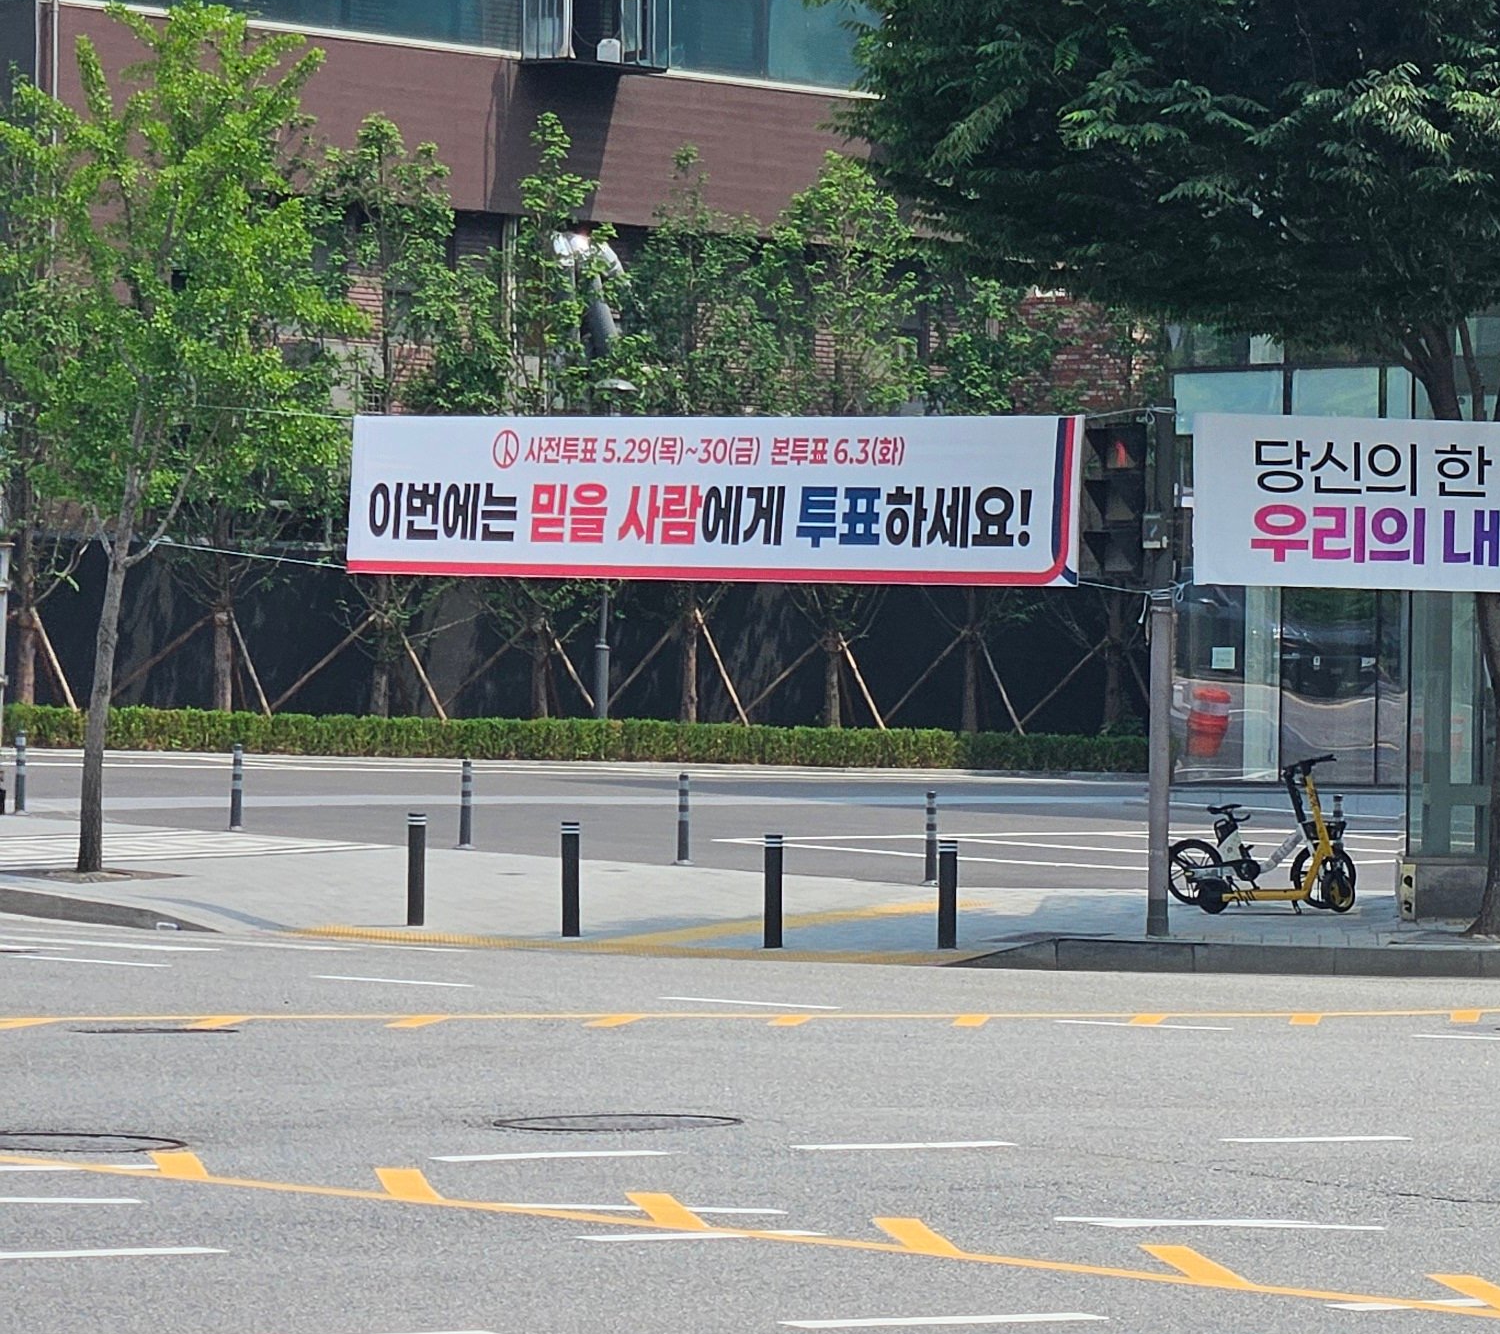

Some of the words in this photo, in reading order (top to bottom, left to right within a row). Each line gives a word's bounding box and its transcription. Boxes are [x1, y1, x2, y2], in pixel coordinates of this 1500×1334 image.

[525, 437, 598, 464] 사전투표
[771, 438, 828, 466] 본투표
[834, 437, 904, 465] 6.3(화)
[1255, 440, 1417, 496] 당신의
[1435, 444, 1492, 497] 한
[369, 483, 517, 541] 이번에는
[531, 483, 607, 543] 믿을
[619, 485, 785, 546] 사람에게
[796, 486, 1032, 548] 투표하세요!
[1251, 505, 1425, 564] 우리의
